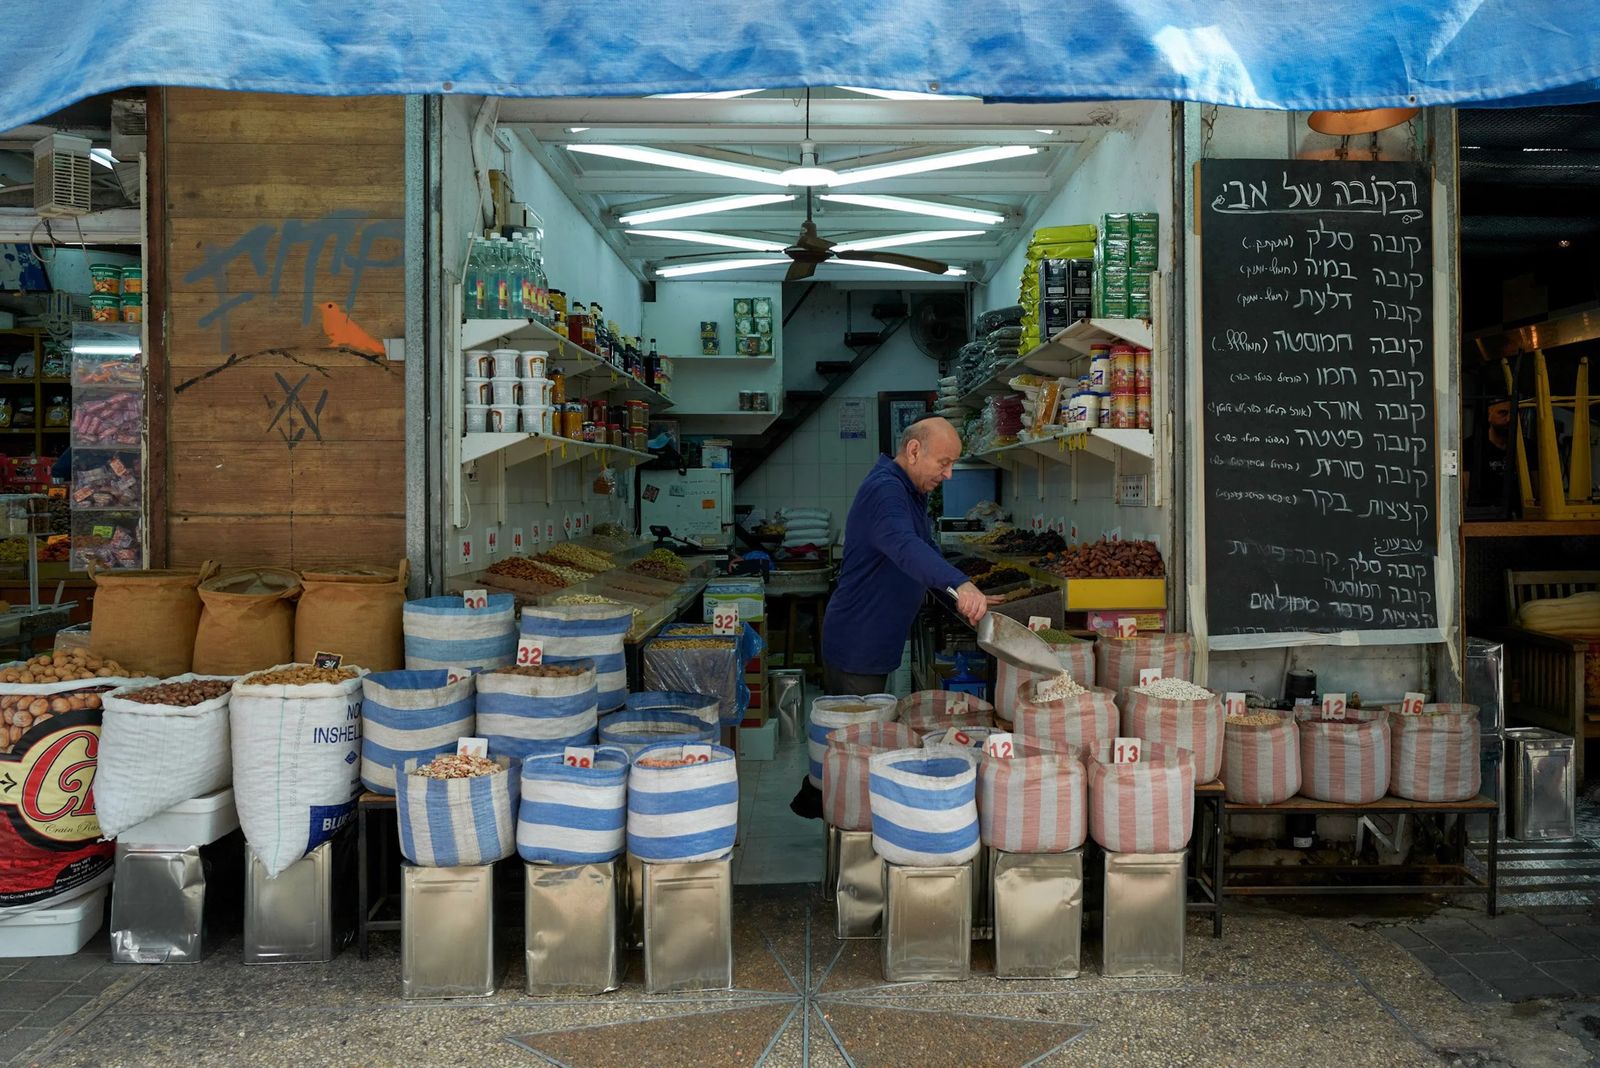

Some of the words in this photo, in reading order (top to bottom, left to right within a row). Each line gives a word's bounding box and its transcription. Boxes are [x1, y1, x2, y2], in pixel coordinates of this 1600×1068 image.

[1223, 180, 1268, 209] אבי
[1283, 171, 1321, 208] של
[1306, 219, 1353, 257] סלק
[1370, 234, 1422, 268] קובה
[1304, 258, 1358, 280] במיה
[1373, 268, 1423, 300] קובה
[1293, 283, 1353, 315] דלעת
[1372, 300, 1422, 336] קובה
[1273, 329, 1353, 353] חמוסטה
[1369, 337, 1423, 367] קובה
[1316, 367, 1358, 386] חמו
[1369, 369, 1424, 400] קובה
[1313, 401, 1363, 420] אורז
[1375, 403, 1426, 434] קובה
[1294, 429, 1363, 449] פטטה
[1373, 433, 1427, 466] קובה
[1309, 458, 1364, 480] סורית
[1374, 464, 1428, 498] קובה
[1301, 489, 1353, 516] בקר
[1356, 499, 1428, 535] קציצות
[1388, 563, 1427, 586] קובה
[1323, 577, 1381, 599] חמוסטה
[1388, 586, 1431, 612] קובה
[714, 614, 734, 629] 32
[1118, 624, 1137, 638] 12
[518, 646, 542, 665] 32
[1226, 698, 1245, 715] 10
[1323, 699, 1344, 715] 12
[1404, 698, 1423, 714] 16
[992, 741, 1013, 759] 12
[1118, 745, 1138, 763] 13
